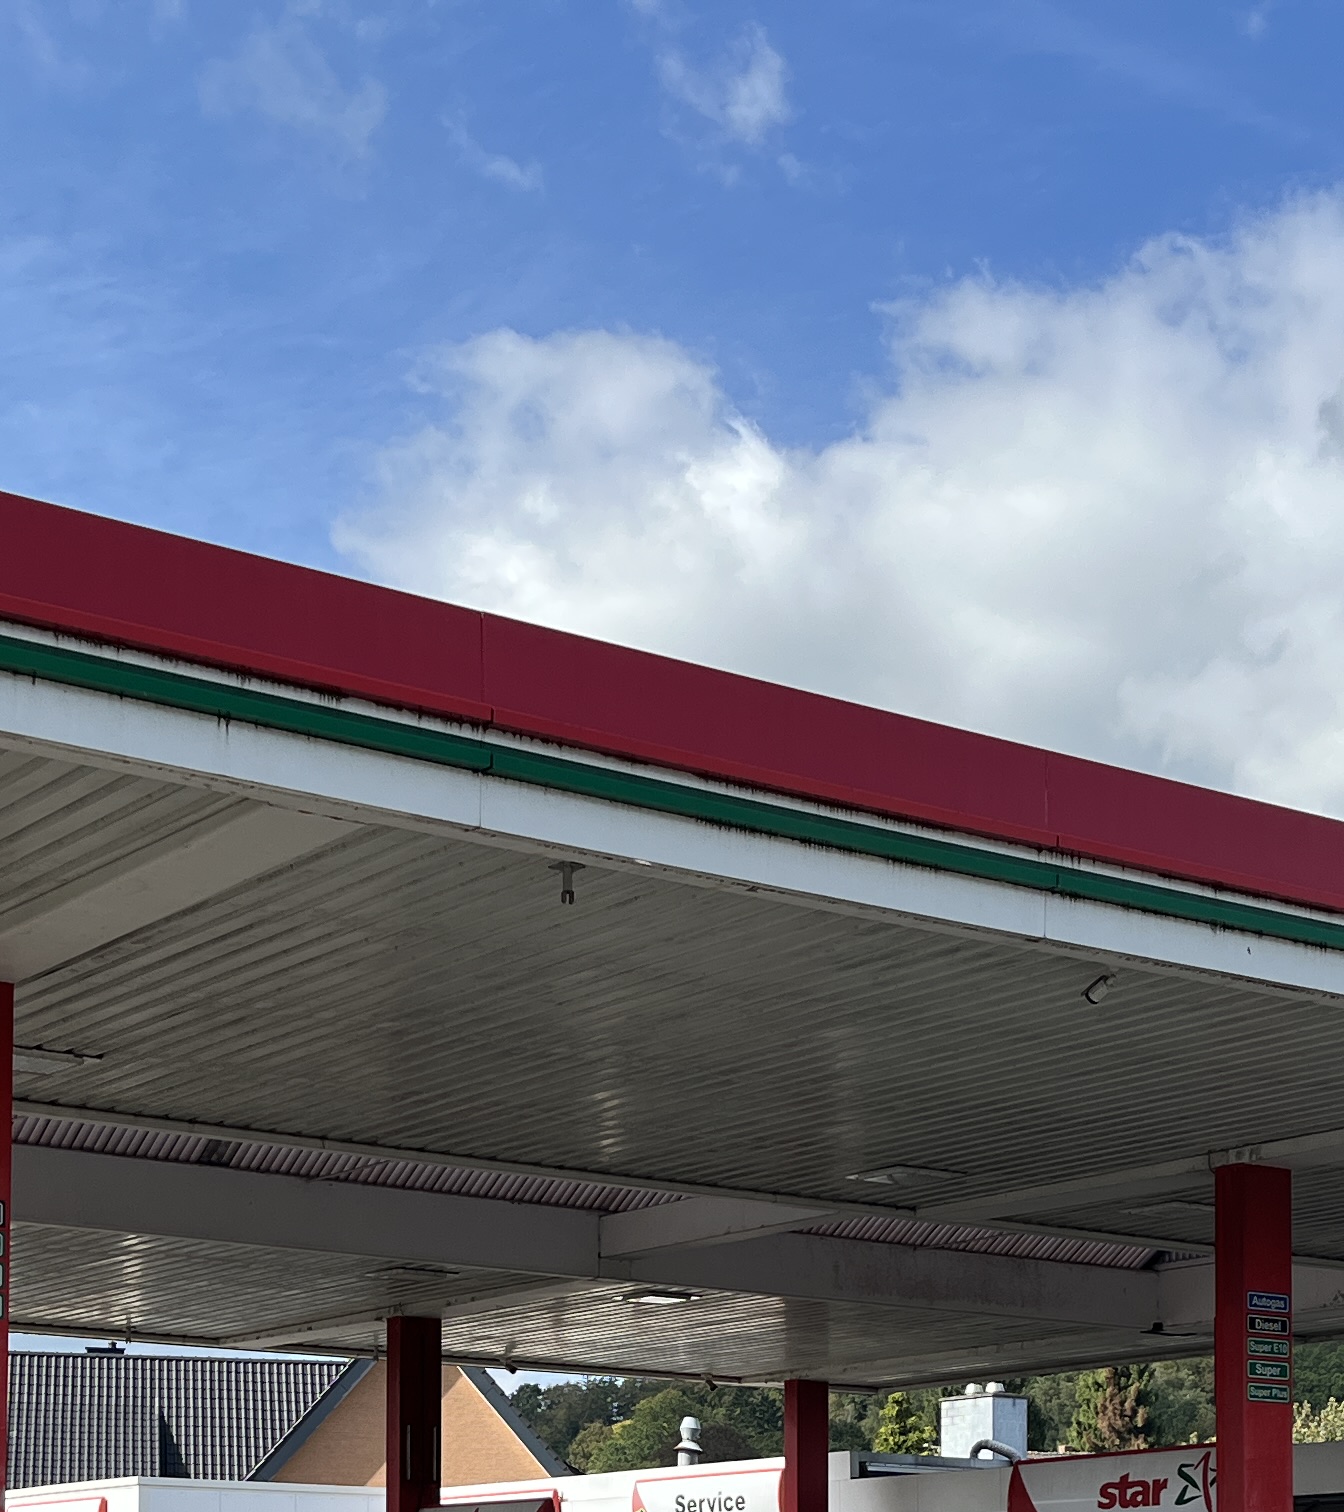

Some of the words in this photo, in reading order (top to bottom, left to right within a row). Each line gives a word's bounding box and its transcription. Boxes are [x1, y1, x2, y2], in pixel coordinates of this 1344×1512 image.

[1255, 1319, 1282, 1331] Diesel
[1250, 1341, 1272, 1353] Super
[1273, 1344, 1287, 1353] E10
[1255, 1364, 1281, 1377] Super
[1250, 1386, 1271, 1397] Super
[1272, 1388, 1287, 1398] Plus
[1097, 1472, 1169, 1510] star
